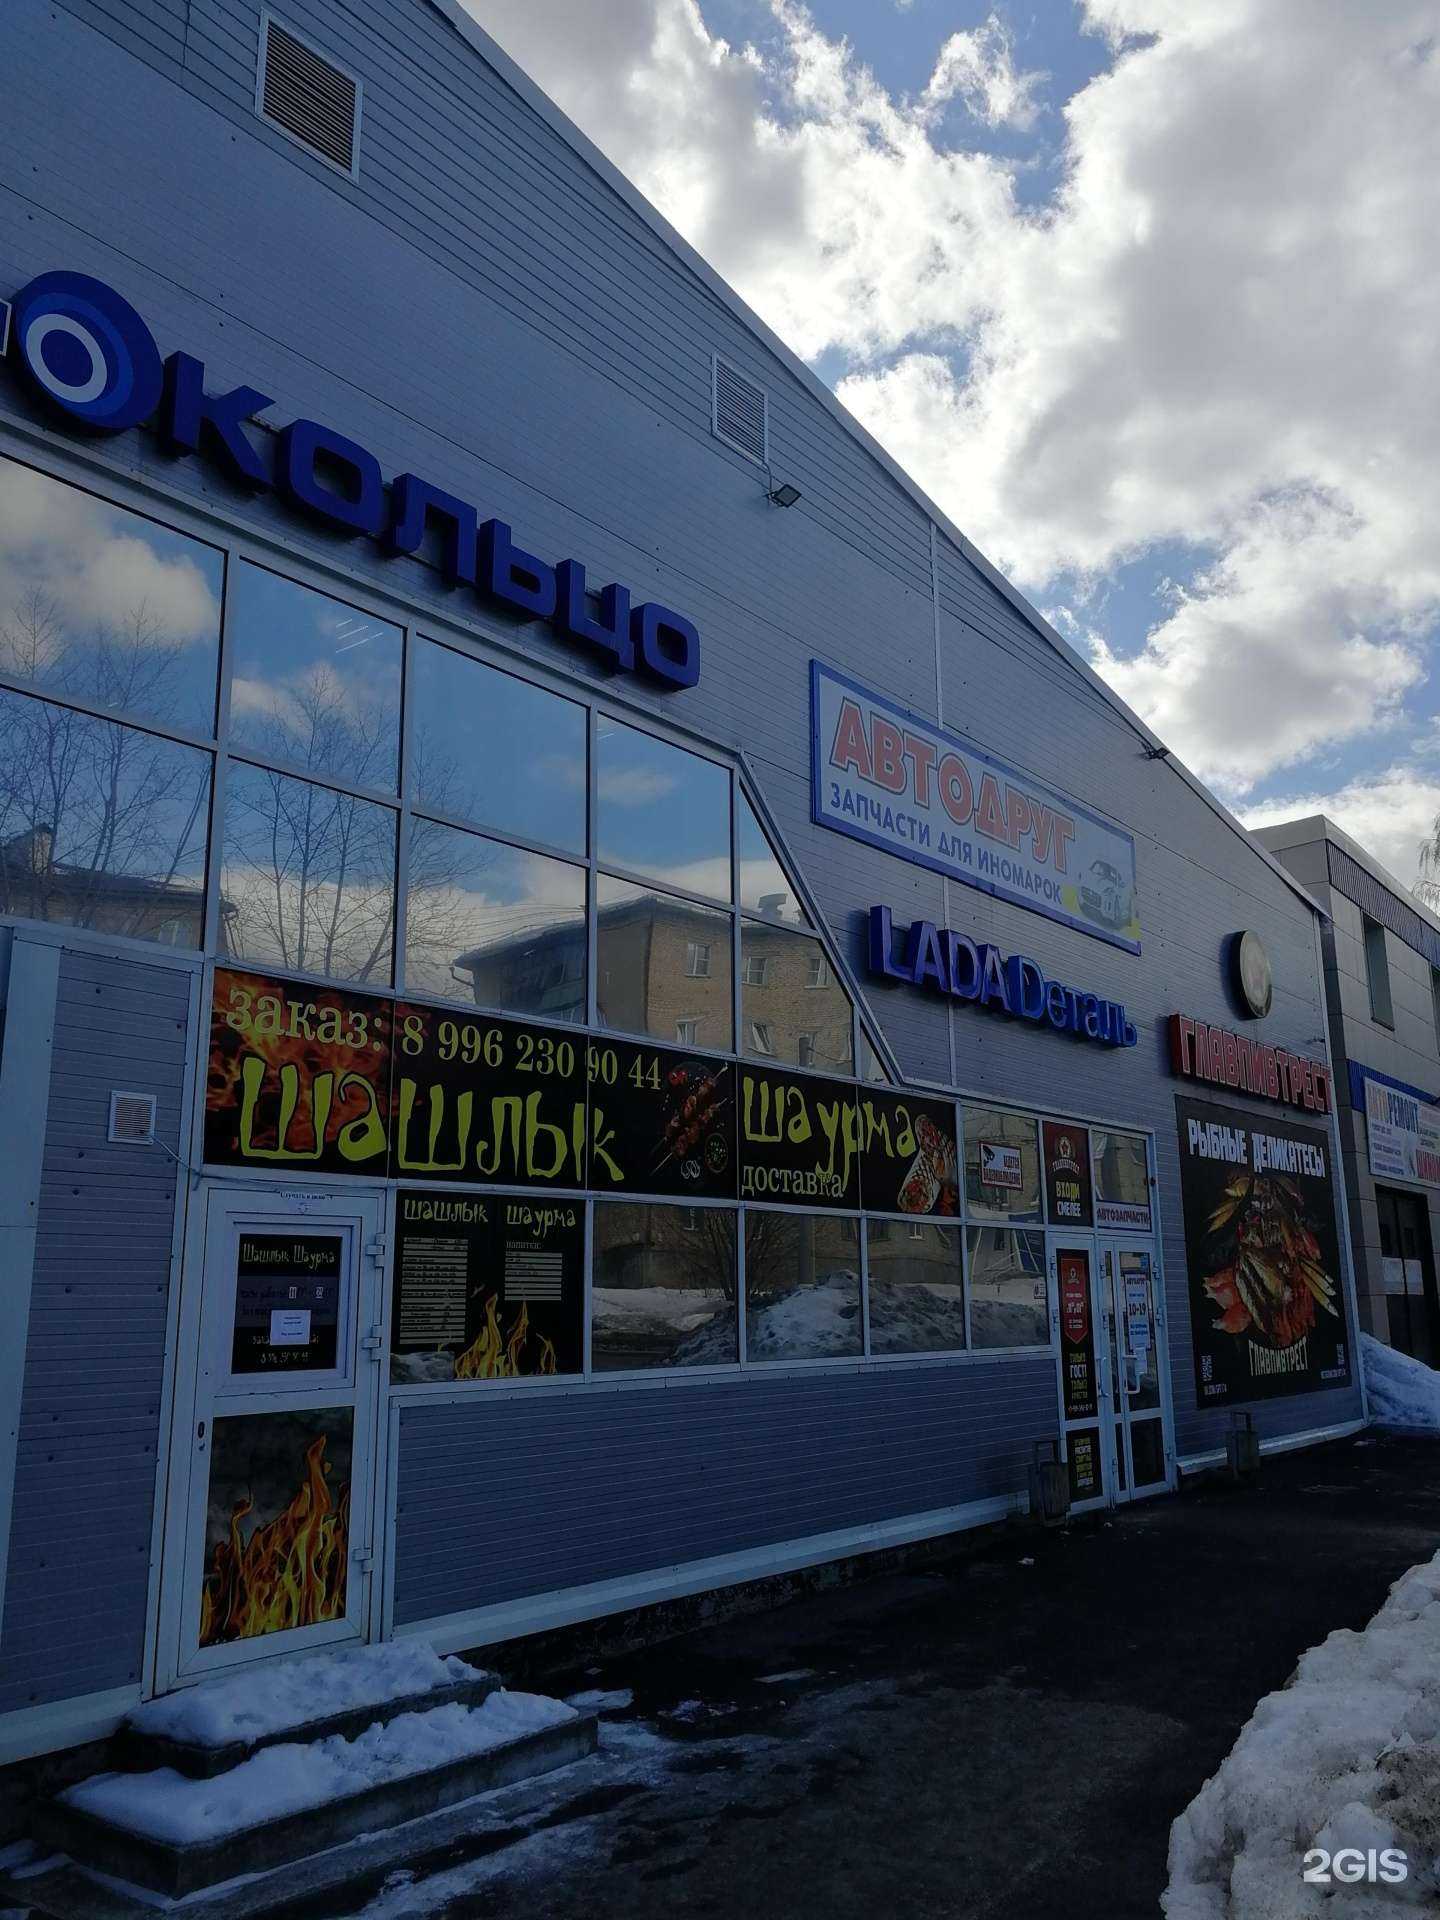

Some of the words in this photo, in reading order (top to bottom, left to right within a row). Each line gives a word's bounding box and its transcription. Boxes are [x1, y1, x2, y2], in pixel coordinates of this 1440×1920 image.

[829, 696, 1075, 874] АВТОДРУГ
[830, 783, 930, 847] ЗАПЧАСТИ
[937, 831, 972, 863] ДЛЯ
[978, 848, 1062, 905] ИНОМАРОК
[401, 1015, 424, 1055] 8
[438, 1021, 503, 1067] 996
[515, 1034, 575, 1078] 230
[587, 1045, 618, 1085] 90
[628, 1054, 661, 1090] 44
[1178, 1015, 1329, 1113] ГЛАВПИВТРЕСТ
[742, 1165, 843, 1198] доставка
[1188, 1119, 1248, 1164] РЫБНЫЕ
[1251, 1132, 1326, 1178] ДЕЛИКАТЕСЫ
[1056, 1182, 1081, 1201] ВХОДИ
[1248, 1337, 1308, 1376] ГЛАВПИВТРЕСТ
